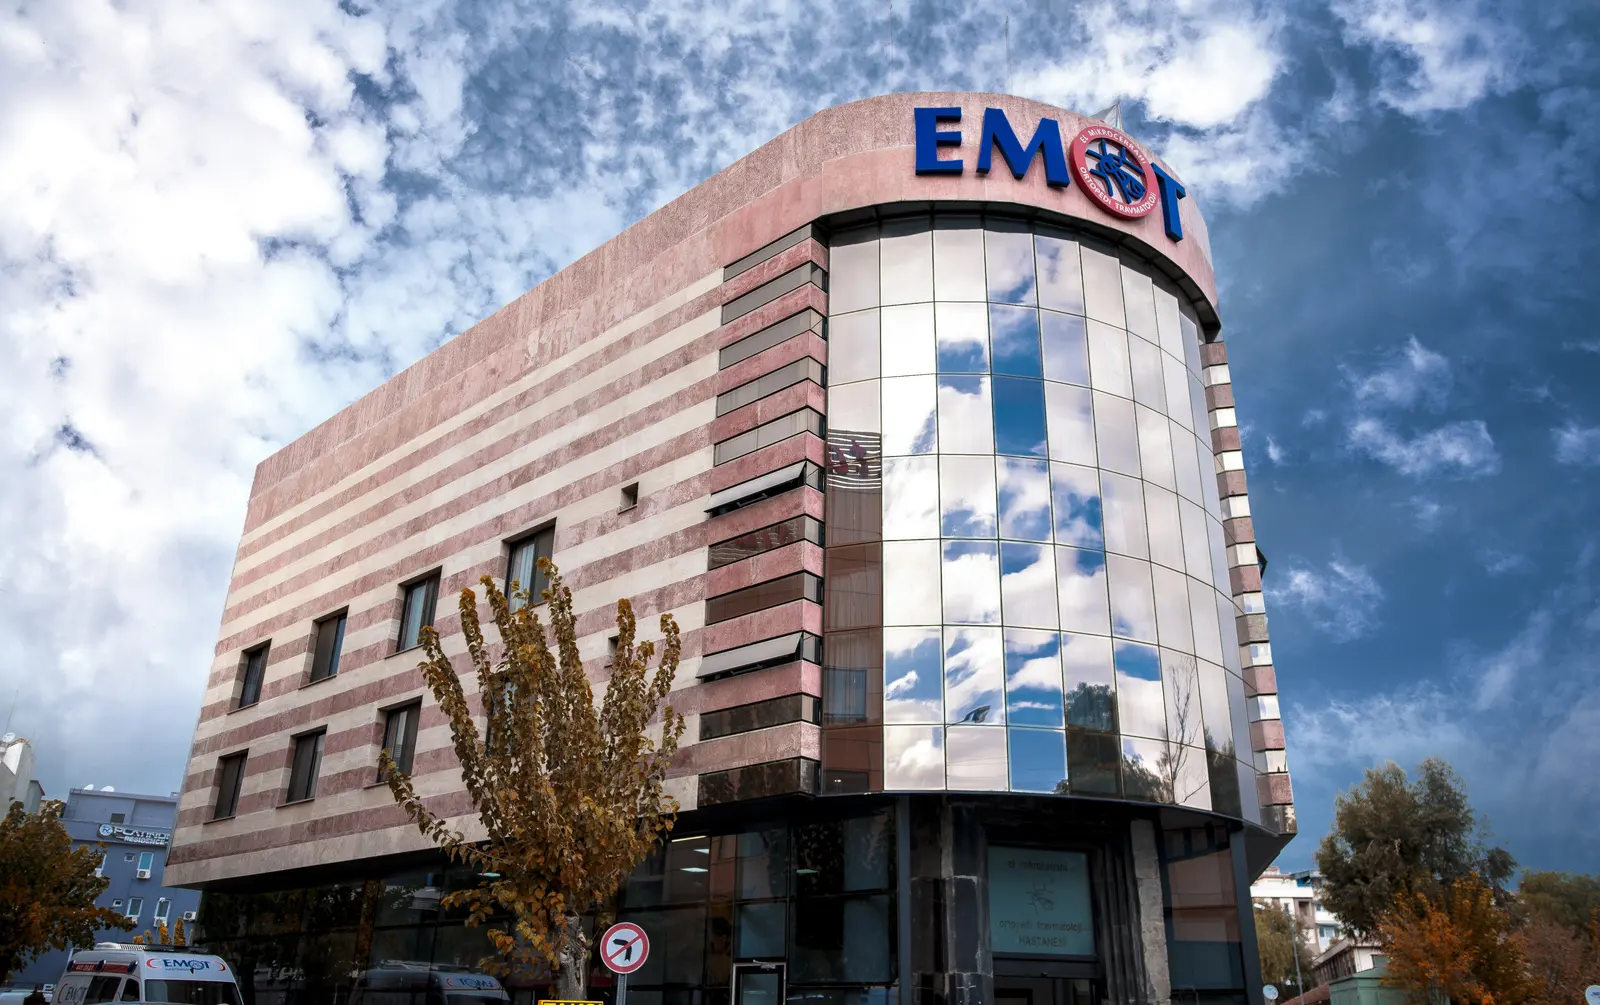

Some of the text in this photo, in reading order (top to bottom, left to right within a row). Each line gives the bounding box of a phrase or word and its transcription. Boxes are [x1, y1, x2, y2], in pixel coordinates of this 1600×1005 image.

[1079, 134, 1088, 144] EL
[914, 107, 1185, 242] EMOT
[124, 836, 165, 845] RESIDENCE
[163, 958, 211, 970] EMOT
